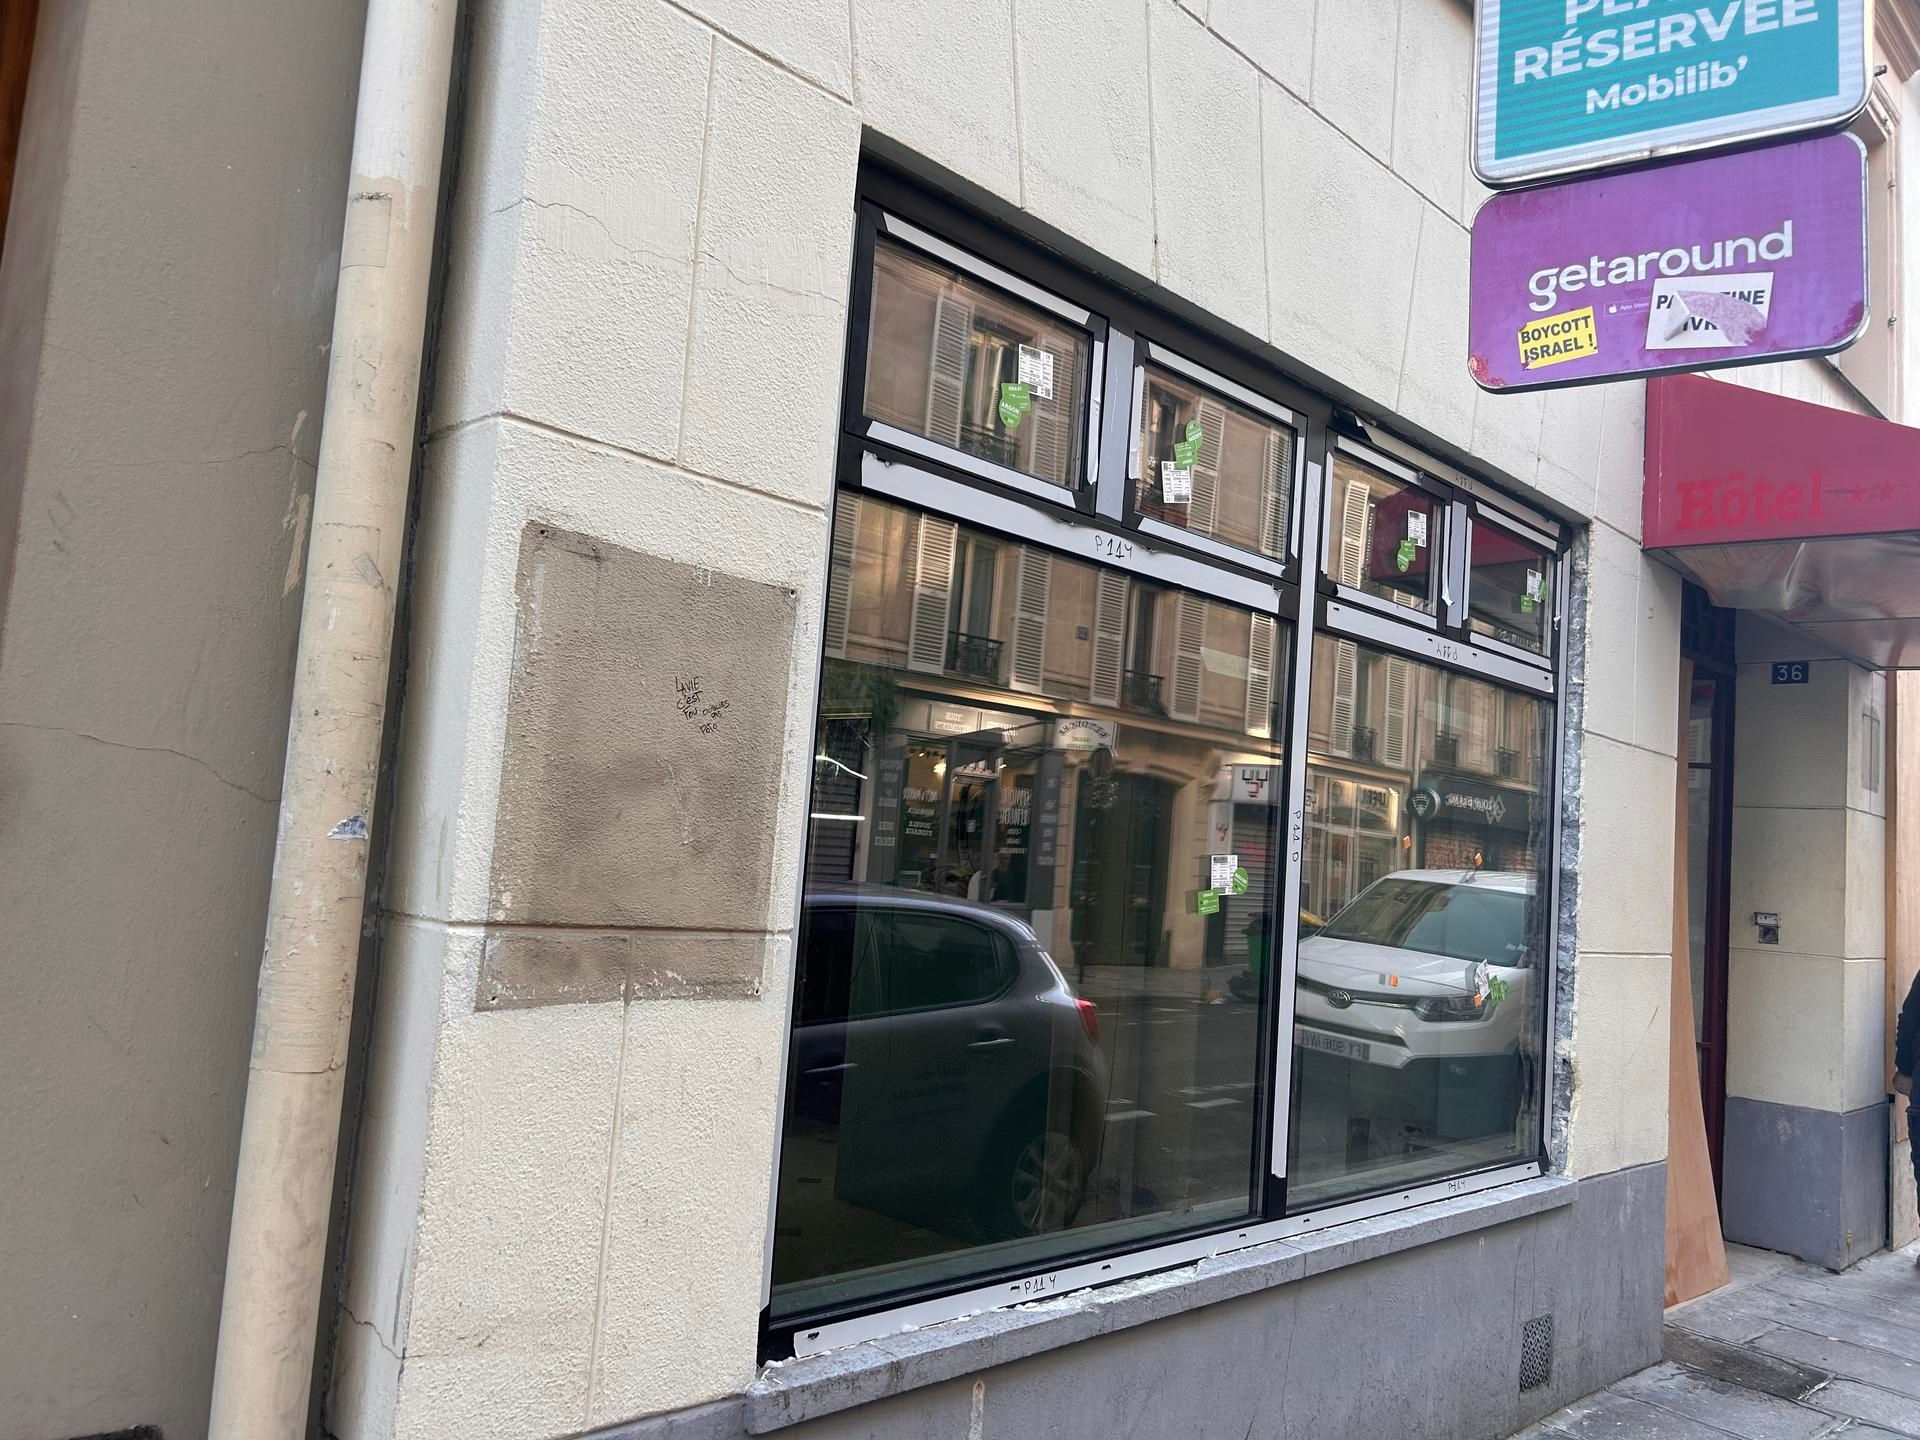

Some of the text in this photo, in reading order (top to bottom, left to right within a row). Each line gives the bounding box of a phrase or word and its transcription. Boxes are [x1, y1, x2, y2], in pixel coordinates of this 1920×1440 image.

[1527, 220, 1793, 313] getaround
[1520, 314, 1592, 345] BOYCOTT
[1523, 336, 1585, 363] ISRAEL
[1675, 469, 1826, 532] Hôtel
[1776, 664, 1803, 682] 36
